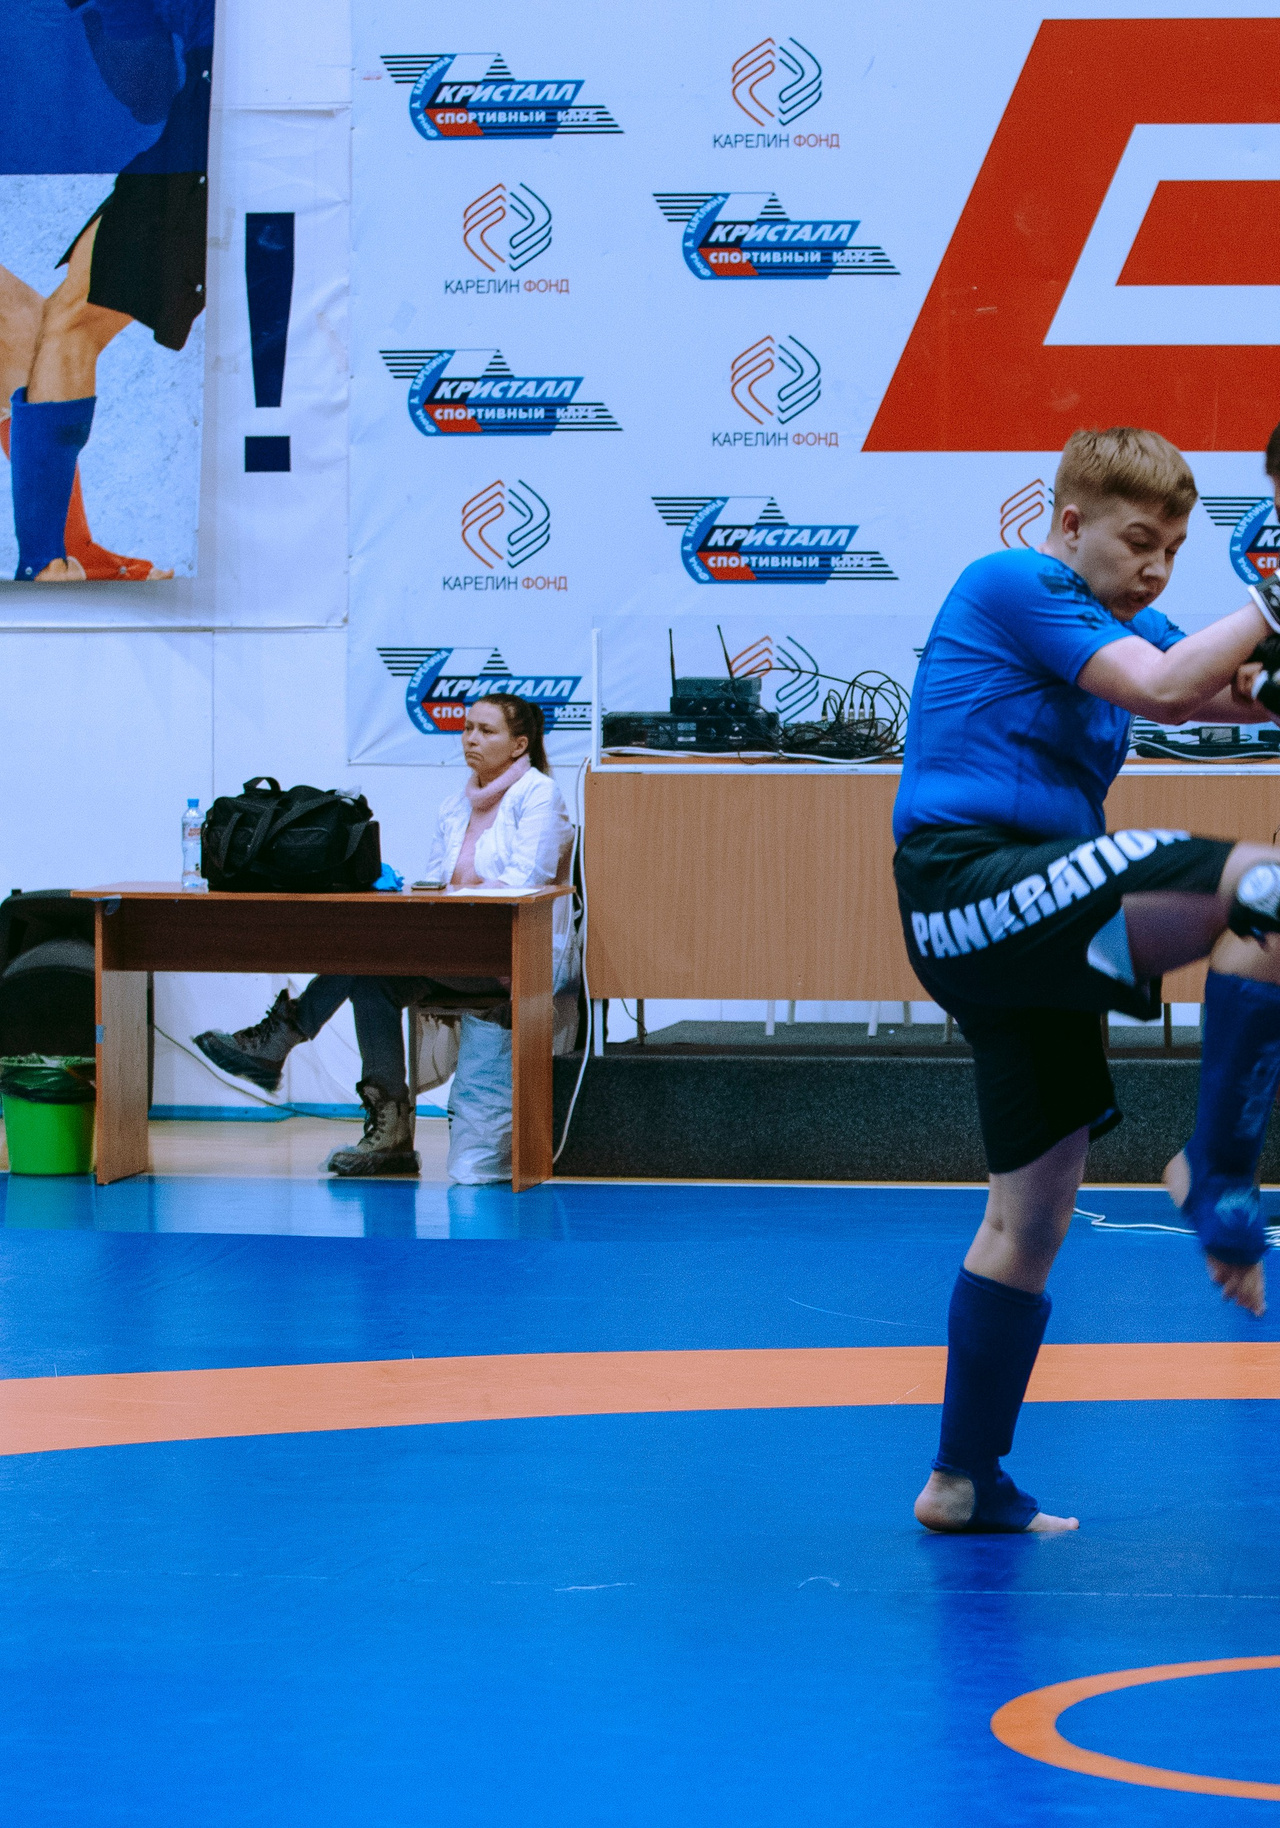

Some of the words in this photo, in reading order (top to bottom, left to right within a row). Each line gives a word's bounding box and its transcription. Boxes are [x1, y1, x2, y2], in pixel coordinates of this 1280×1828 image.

[413, 56, 452, 94] КАРЕЛИНА
[435, 83, 577, 103] КРИСТАЛЛ
[436, 111, 547, 124] СПОРТИВНЫЙ
[713, 134, 789, 149] КАРЕЛИН
[793, 133, 840, 151] ФОНД
[686, 195, 725, 234] КАРЕЛИНА
[708, 224, 852, 242] КРИСТАЛЛ
[709, 251, 821, 264] СПОРТИВНЫЙ
[444, 279, 520, 295] КАРЕЛИН
[523, 278, 569, 296] ФОНД
[412, 352, 451, 390] КАРЕЛИНА
[434, 380, 576, 400] КРИСТАЛЛ
[434, 407, 545, 420] СПОРТИВНЫЙ
[711, 431, 789, 447] КАРЕЛИН
[792, 430, 839, 448] ФОНД
[685, 498, 725, 538] КАРЕЛИНА
[1233, 499, 1273, 537] КАРЕЛИНА
[707, 528, 851, 547] КРИСТАЛЛ
[708, 555, 820, 568] СПОРТИВНЫЙ
[442, 575, 518, 591] КАРЕЛИН
[522, 574, 568, 592] ФОНД
[410, 650, 450, 688] КАРЕЛИНА
[432, 679, 574, 698] КРИСТАЛЛ
